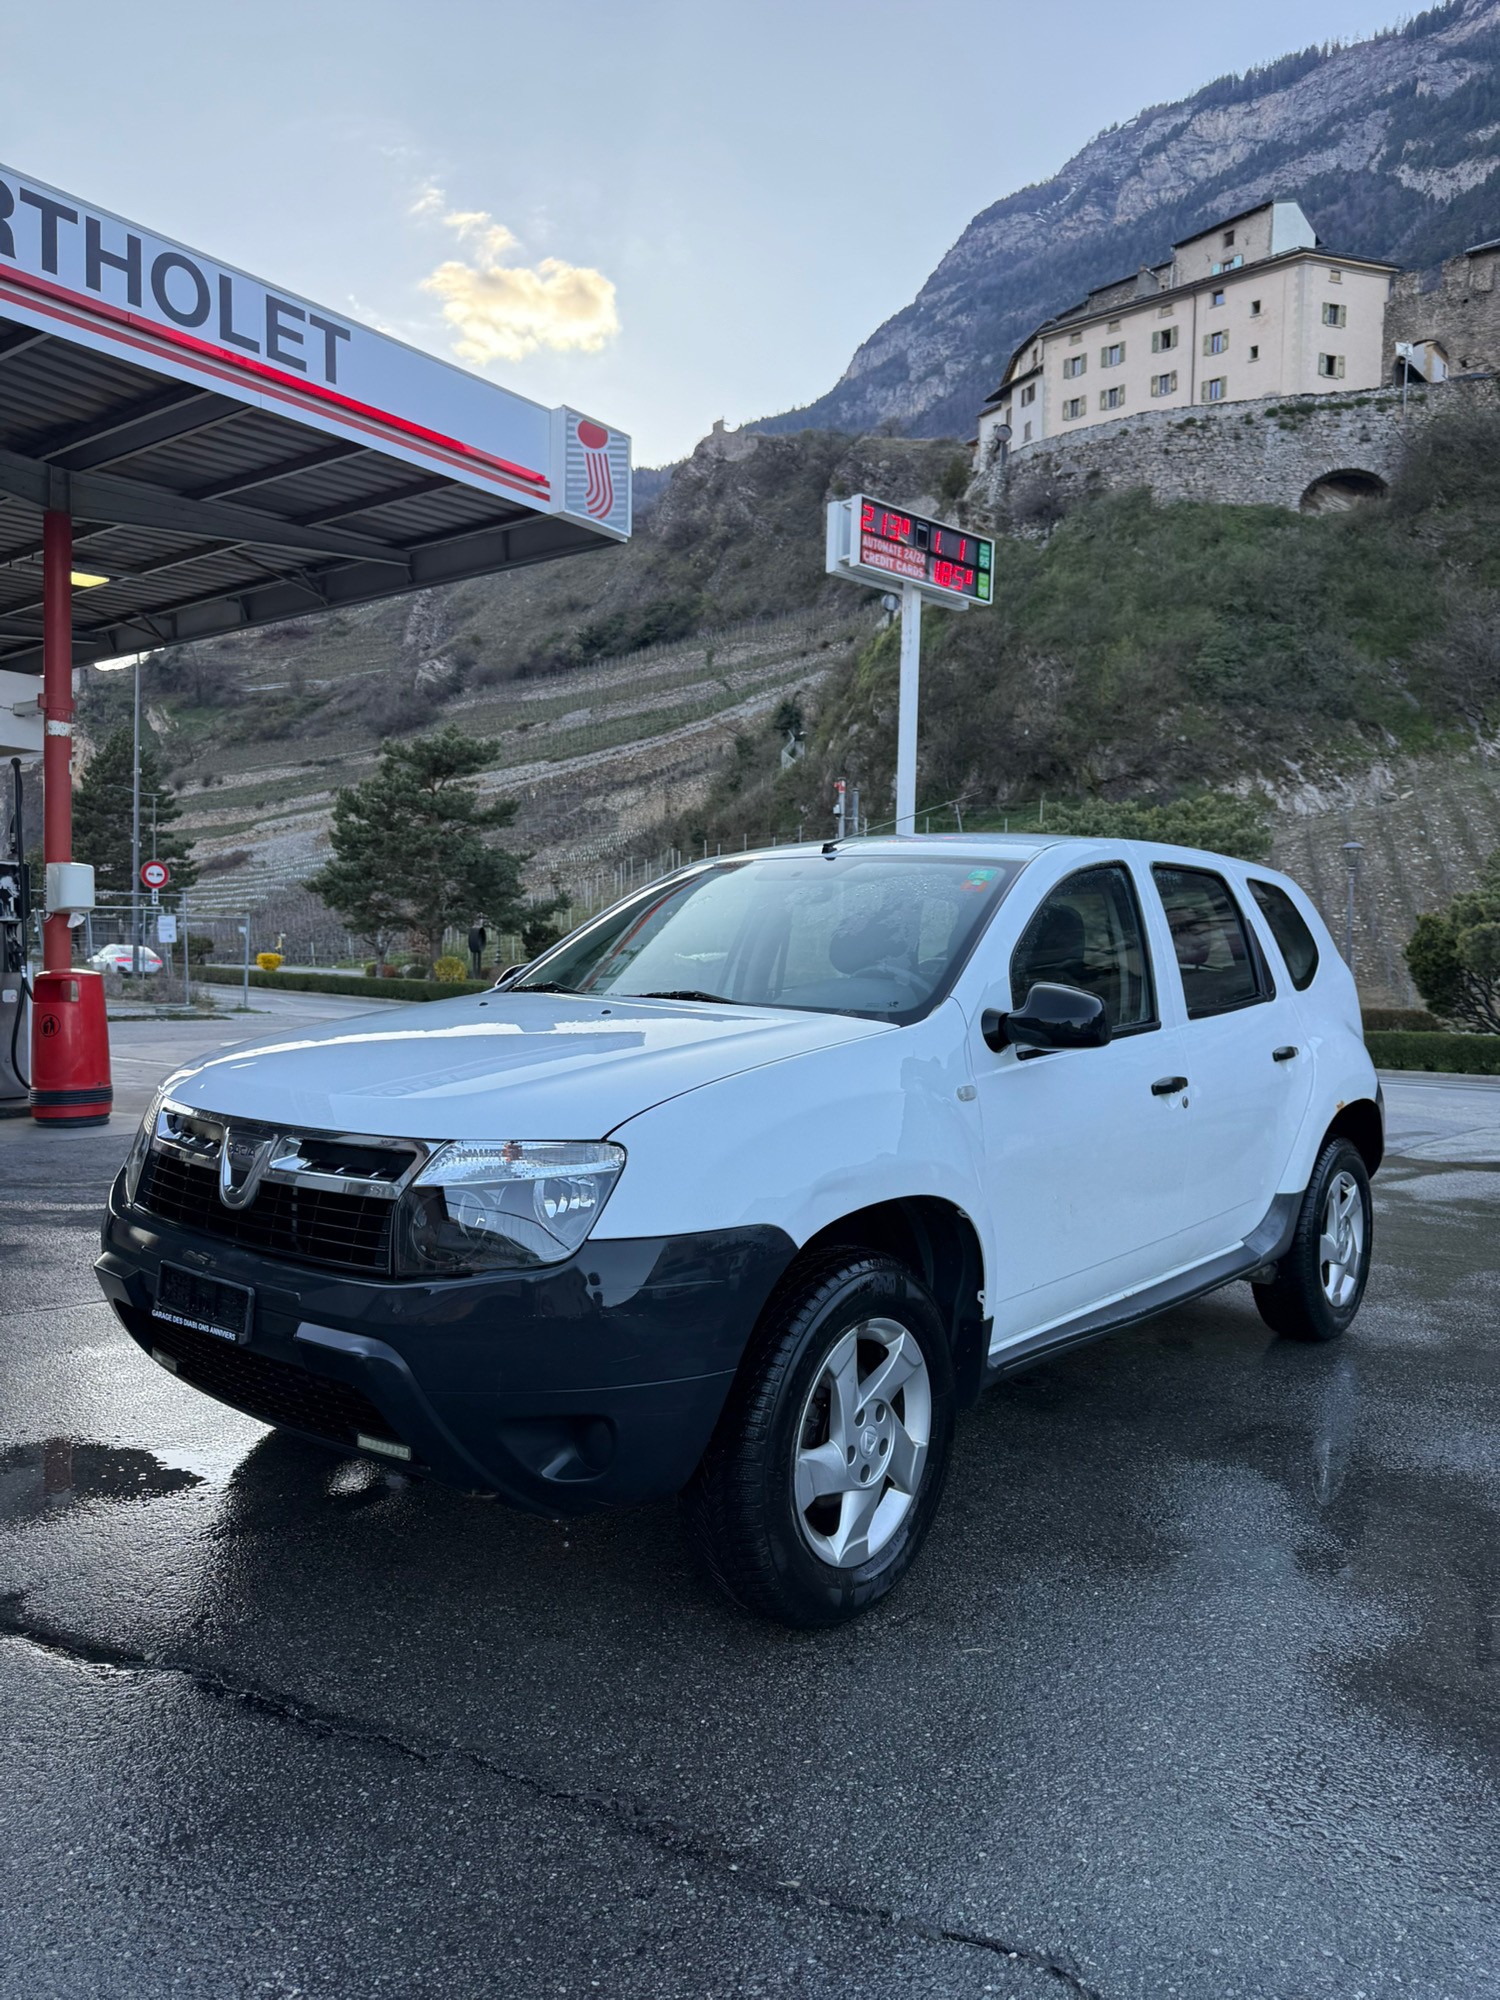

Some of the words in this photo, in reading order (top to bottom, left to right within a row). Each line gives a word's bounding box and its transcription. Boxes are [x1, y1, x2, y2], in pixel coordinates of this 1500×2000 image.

[862, 534, 902, 558] AUTOMATE
[903, 547, 926, 566] 24/24
[862, 550, 895, 569] CREDIT
[895, 559, 925, 578] CARDS
[151, 1309, 173, 1322] GARAGE
[172, 1315, 184, 1325] DES
